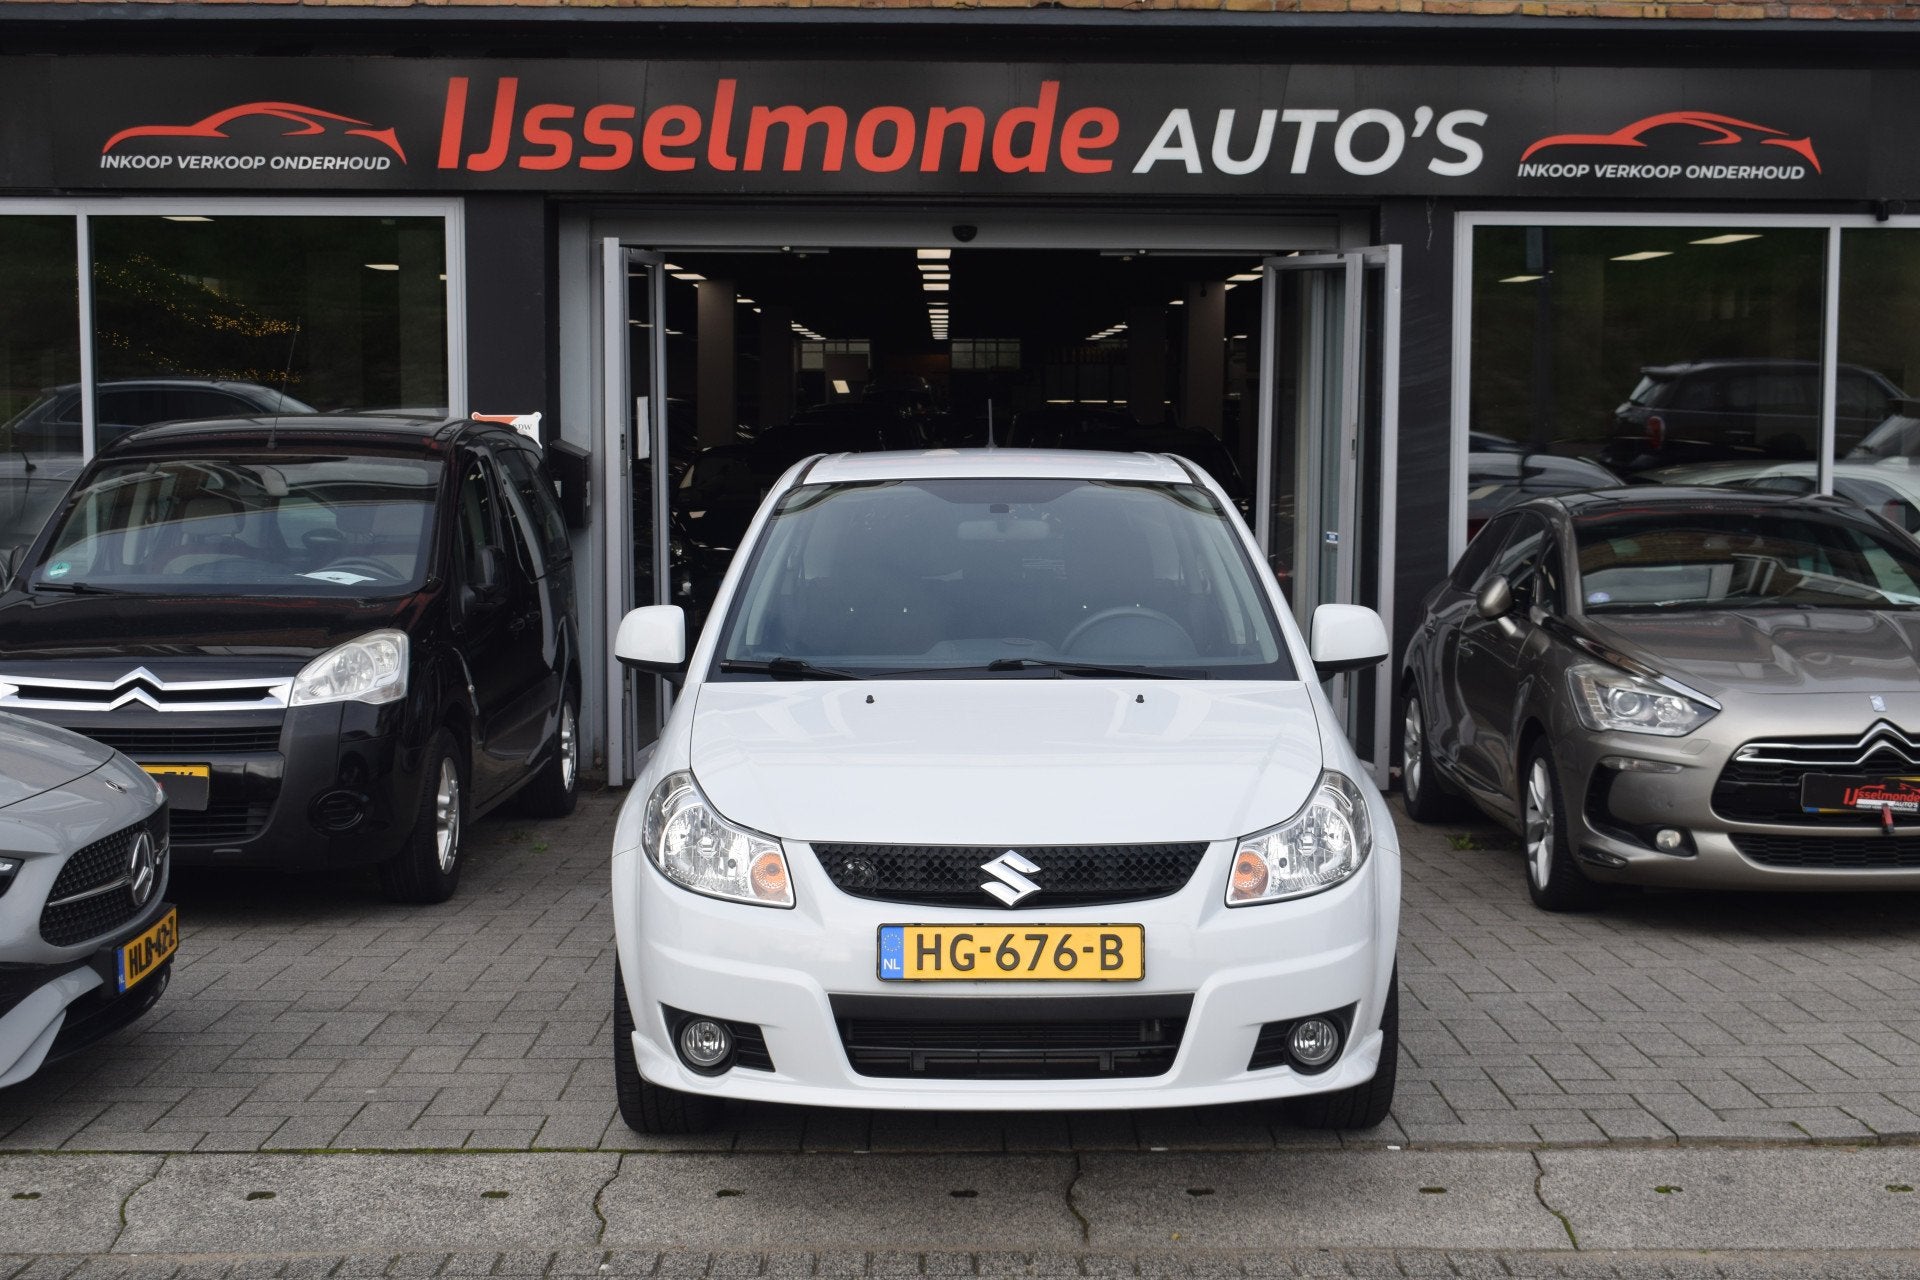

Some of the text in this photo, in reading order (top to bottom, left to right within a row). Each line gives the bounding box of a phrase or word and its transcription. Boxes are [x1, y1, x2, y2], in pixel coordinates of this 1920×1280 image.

[437, 77, 1488, 177] IJsselmonde AUTO'S
[100, 155, 391, 171] INKOOP VERKOOP ONDERHOUD
[1517, 163, 1806, 180] INKOOP VERKOOP ONDERHOUD
[883, 934, 1124, 971] NL HG-676-B
